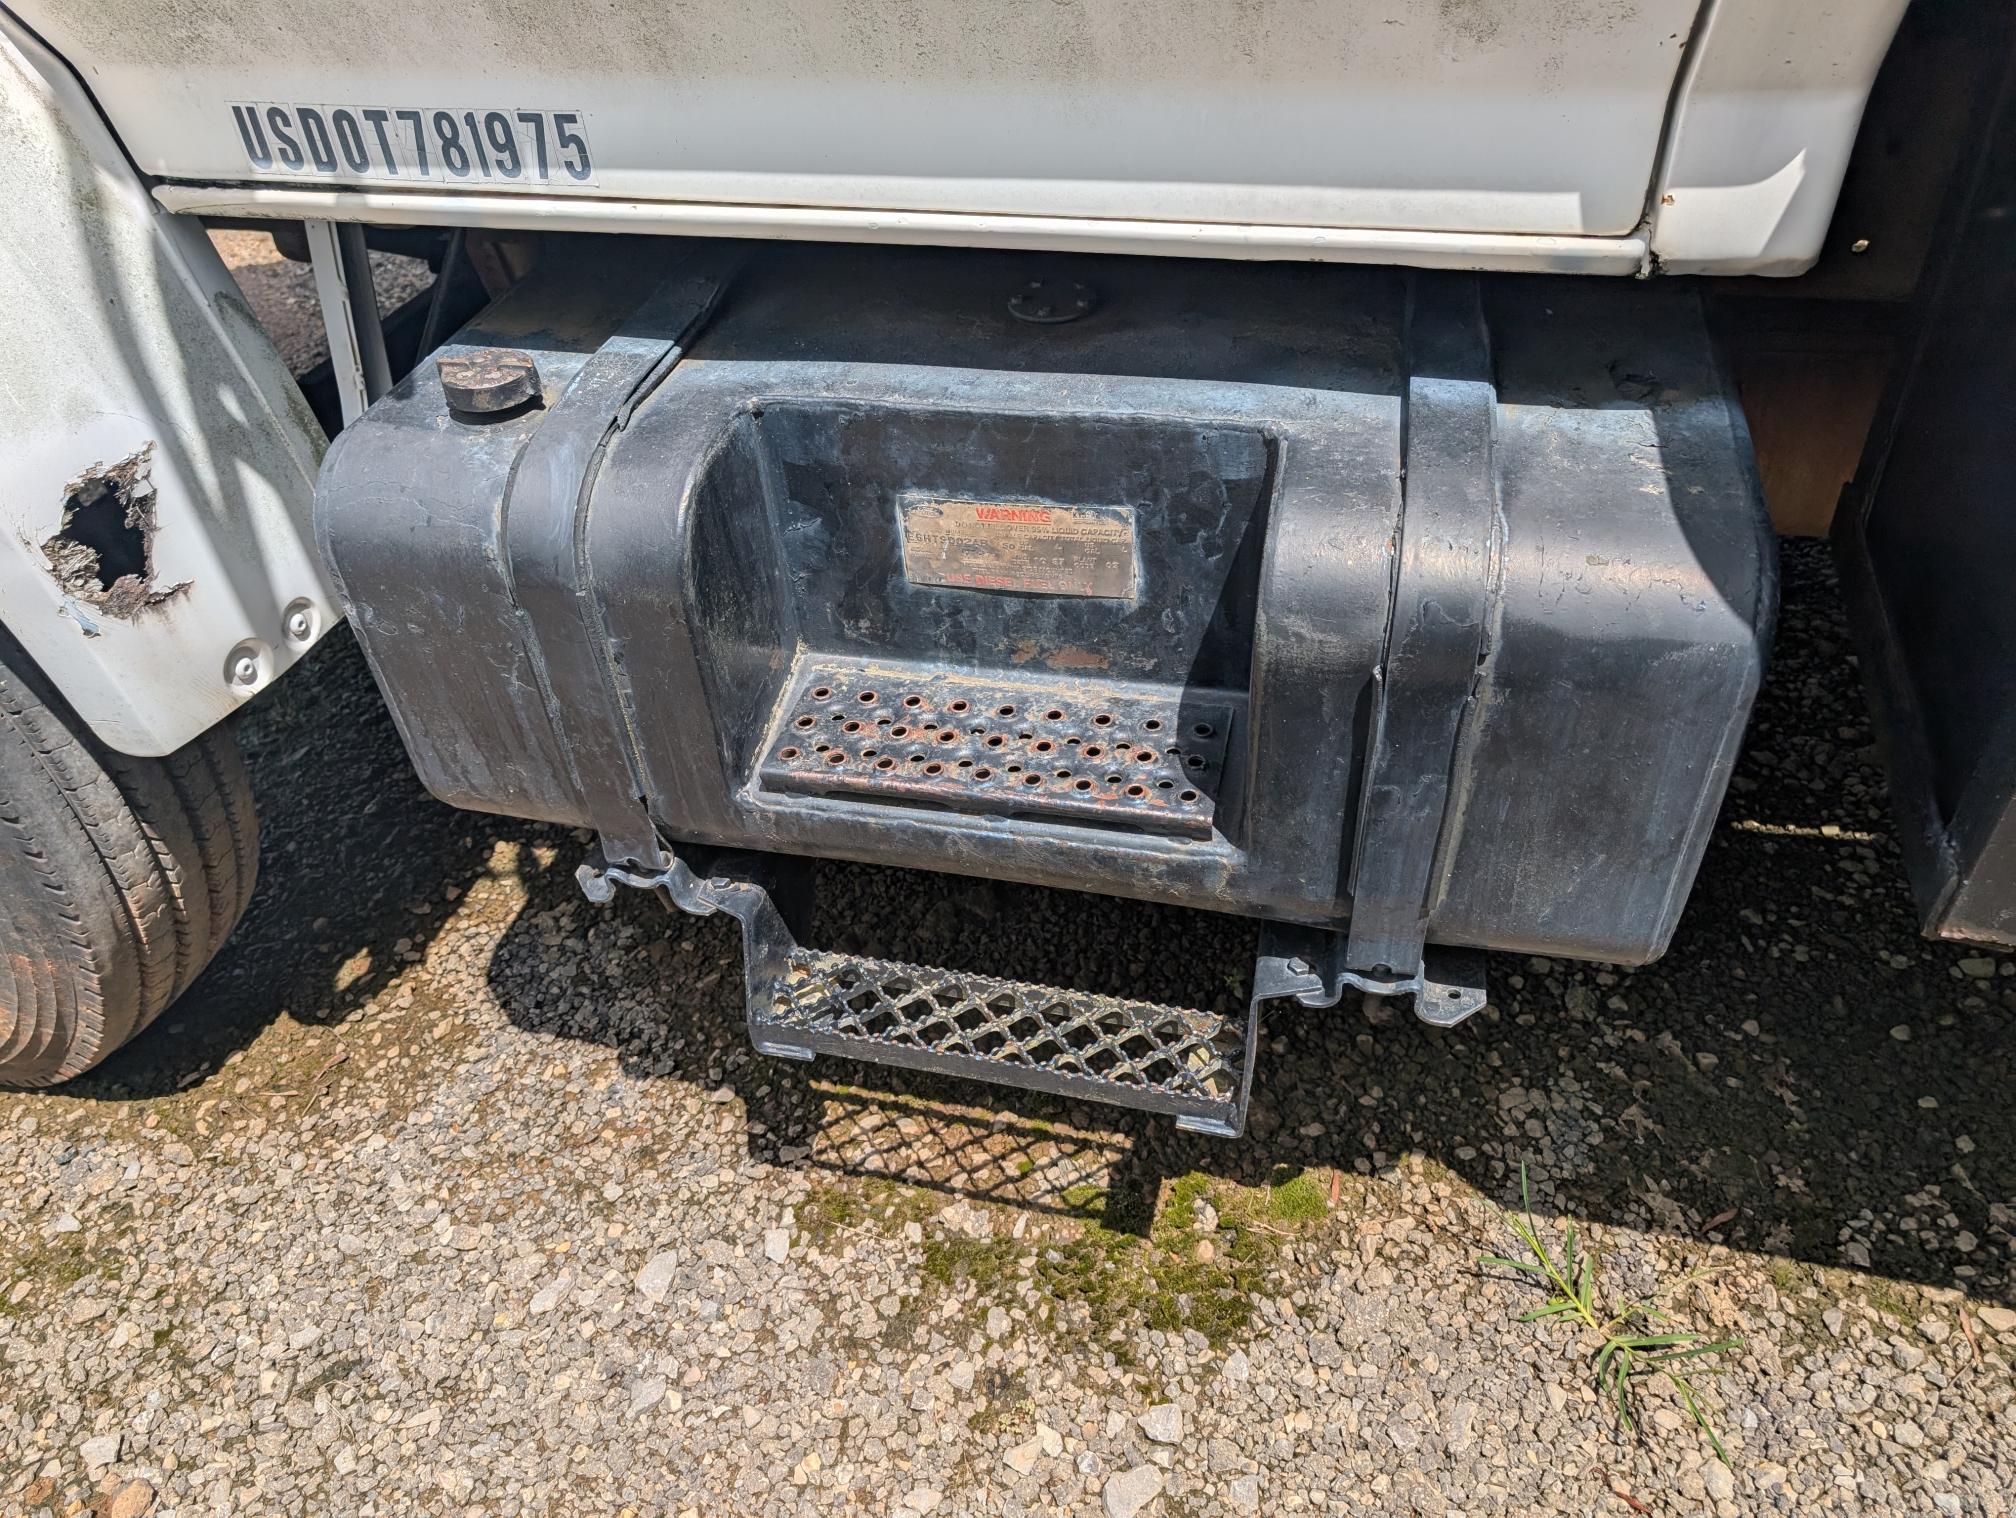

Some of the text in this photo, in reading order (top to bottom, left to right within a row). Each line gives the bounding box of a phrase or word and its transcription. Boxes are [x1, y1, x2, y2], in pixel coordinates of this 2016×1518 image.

[231, 105, 592, 181] USDOT781975
[976, 507, 1052, 522] WARNING
[1051, 527, 1078, 535] LIQUID
[1081, 528, 1123, 537] CAPACITY
[945, 573, 971, 585] USE
